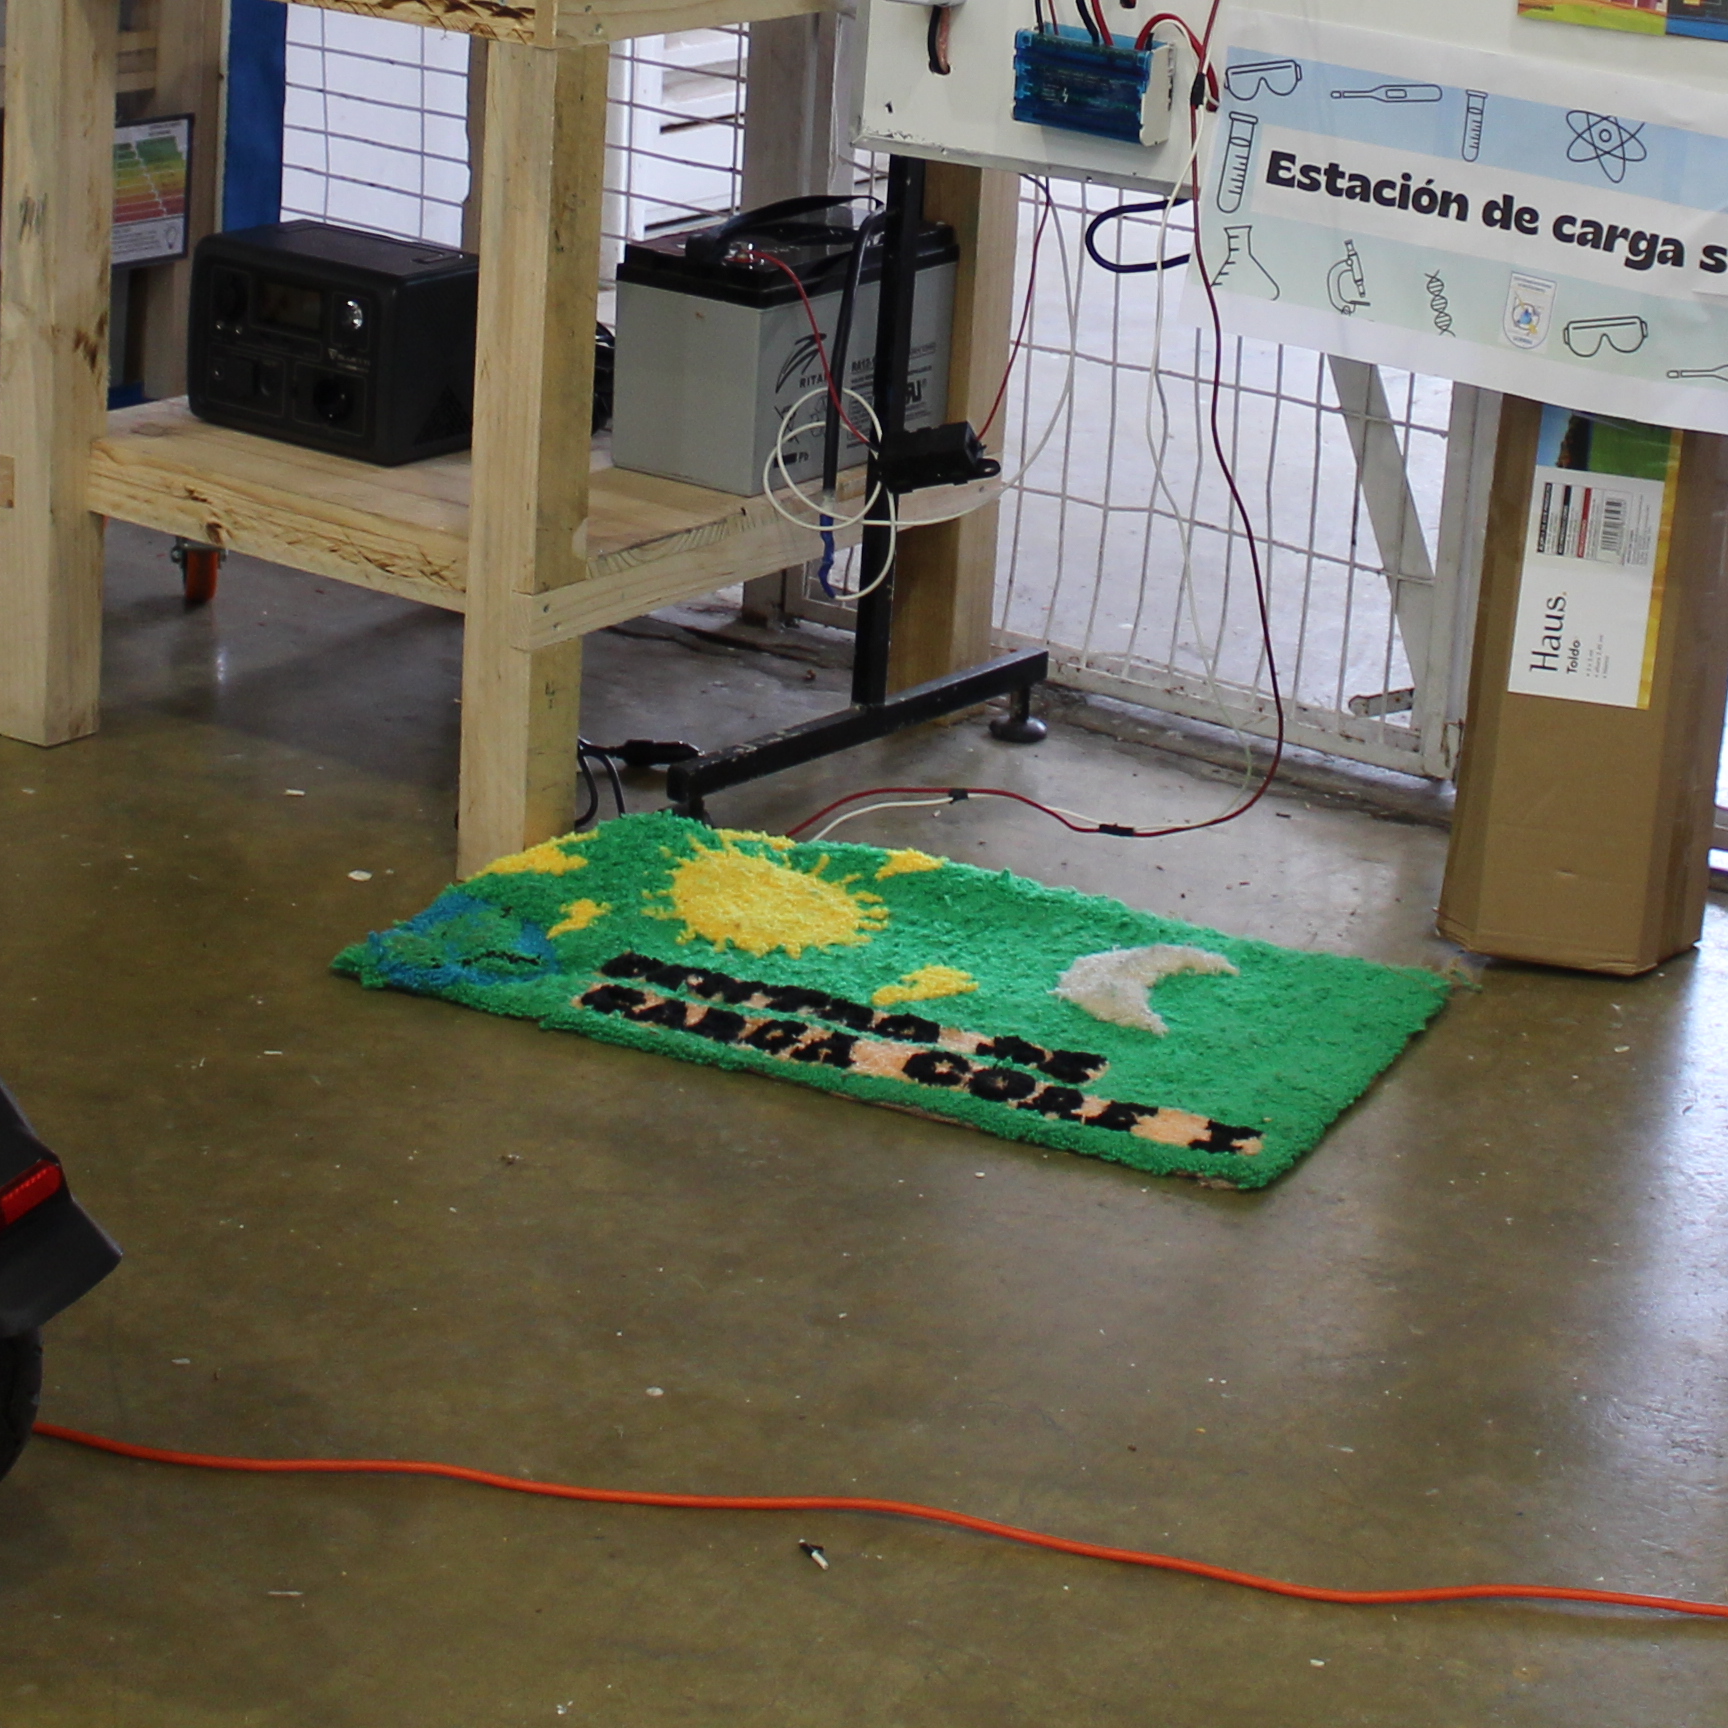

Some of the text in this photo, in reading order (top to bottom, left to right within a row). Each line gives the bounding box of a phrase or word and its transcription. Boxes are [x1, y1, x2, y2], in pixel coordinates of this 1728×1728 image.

[1265, 150, 1469, 223] Estación
[1481, 194, 1540, 236] de
[1553, 212, 1686, 271] carga
[1566, 639, 1582, 675] Toldo
